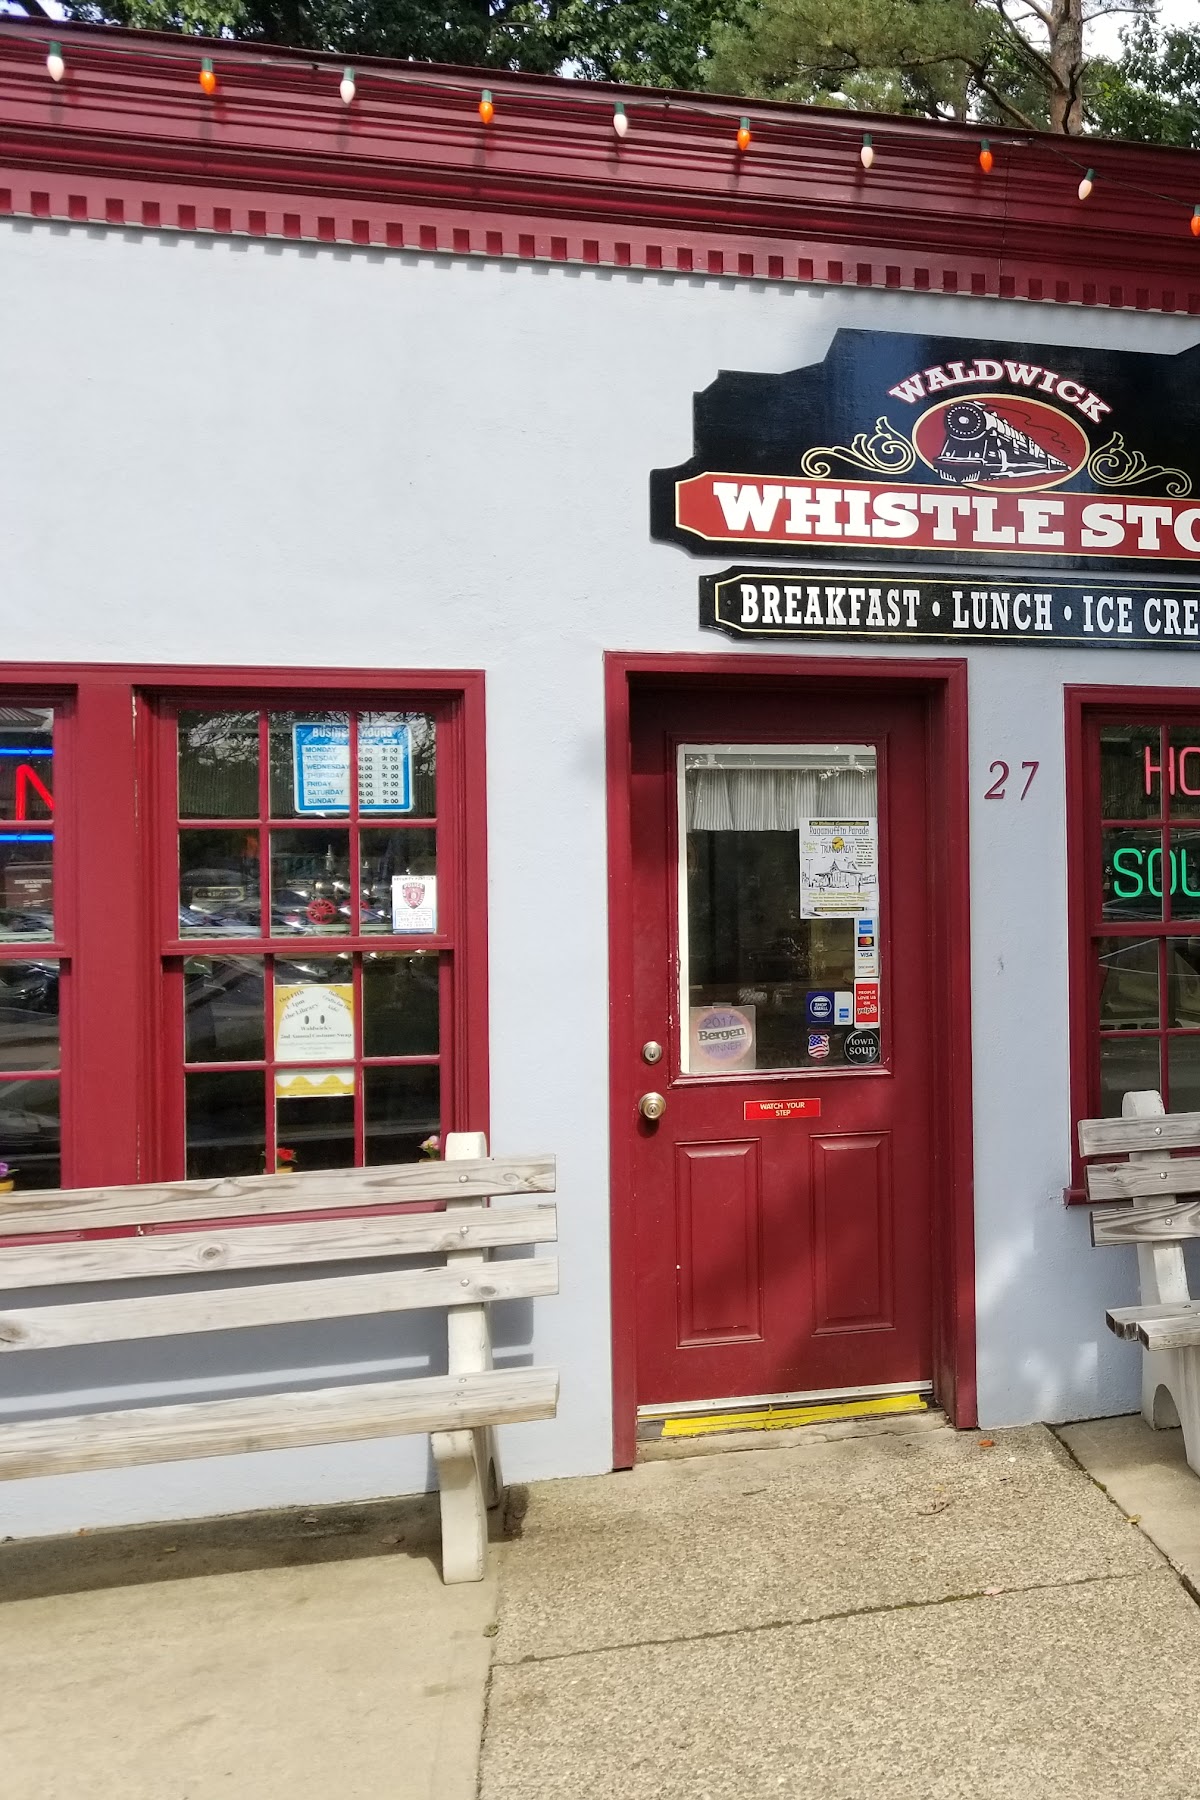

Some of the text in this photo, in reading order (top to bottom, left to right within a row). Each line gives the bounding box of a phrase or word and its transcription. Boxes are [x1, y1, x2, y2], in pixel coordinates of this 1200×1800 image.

[889, 359, 1111, 423] WALDWICK
[713, 482, 1064, 547] WHISTLE
[740, 584, 920, 628] BREAKFAST
[951, 590, 1052, 632] LUNCH
[1082, 596, 1133, 634] ICE
[984, 760, 1040, 800] 27
[809, 826, 870, 836] Ragamuffin Parade
[703, 1014, 734, 1029] 2017
[698, 1027, 746, 1041] Bergen
[706, 1042, 742, 1053] WINNER
[849, 1045, 876, 1056] soup
[760, 1102, 784, 1110] WATCH
